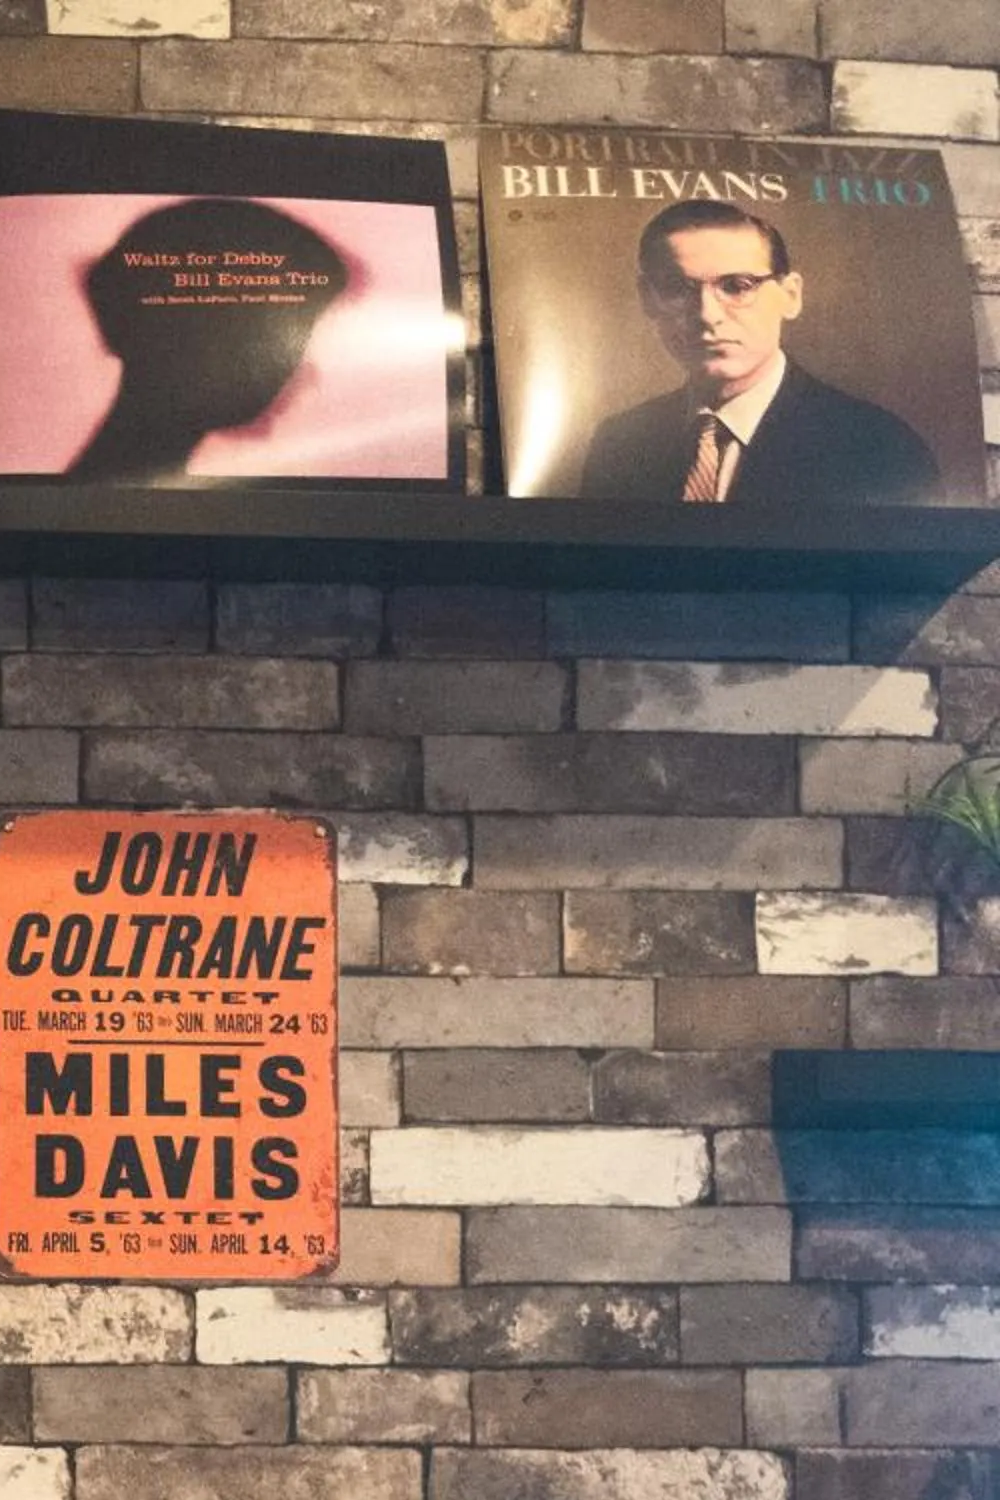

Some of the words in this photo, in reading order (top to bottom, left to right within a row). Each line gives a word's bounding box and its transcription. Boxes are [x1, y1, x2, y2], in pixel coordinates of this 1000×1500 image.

[502, 165, 617, 198] BILL
[631, 168, 788, 200] EVANS
[811, 173, 932, 206] TRIO
[123, 252, 180, 268] Waltz
[186, 252, 217, 266] for
[223, 252, 286, 268] Debby
[173, 273, 210, 287] Bill
[218, 272, 281, 287] Evans
[286, 271, 329, 286] Trio
[74, 831, 258, 897] JOHN
[6, 912, 326, 981] COLTRANE
[50, 989, 280, 1005] QUARTET
[2, 1010, 31, 1031] TUE.
[37, 1010, 87, 1031] MARCH
[95, 1011, 126, 1032] 19
[214, 1013, 263, 1034] MARCH
[269, 1013, 302, 1035] 24
[24, 1051, 307, 1118] MILES
[34, 1133, 300, 1201] DAVIS
[68, 1210, 264, 1225] SEXTET
[41, 1231, 81, 1253] APRIL
[211, 1233, 249, 1255] APRIL
